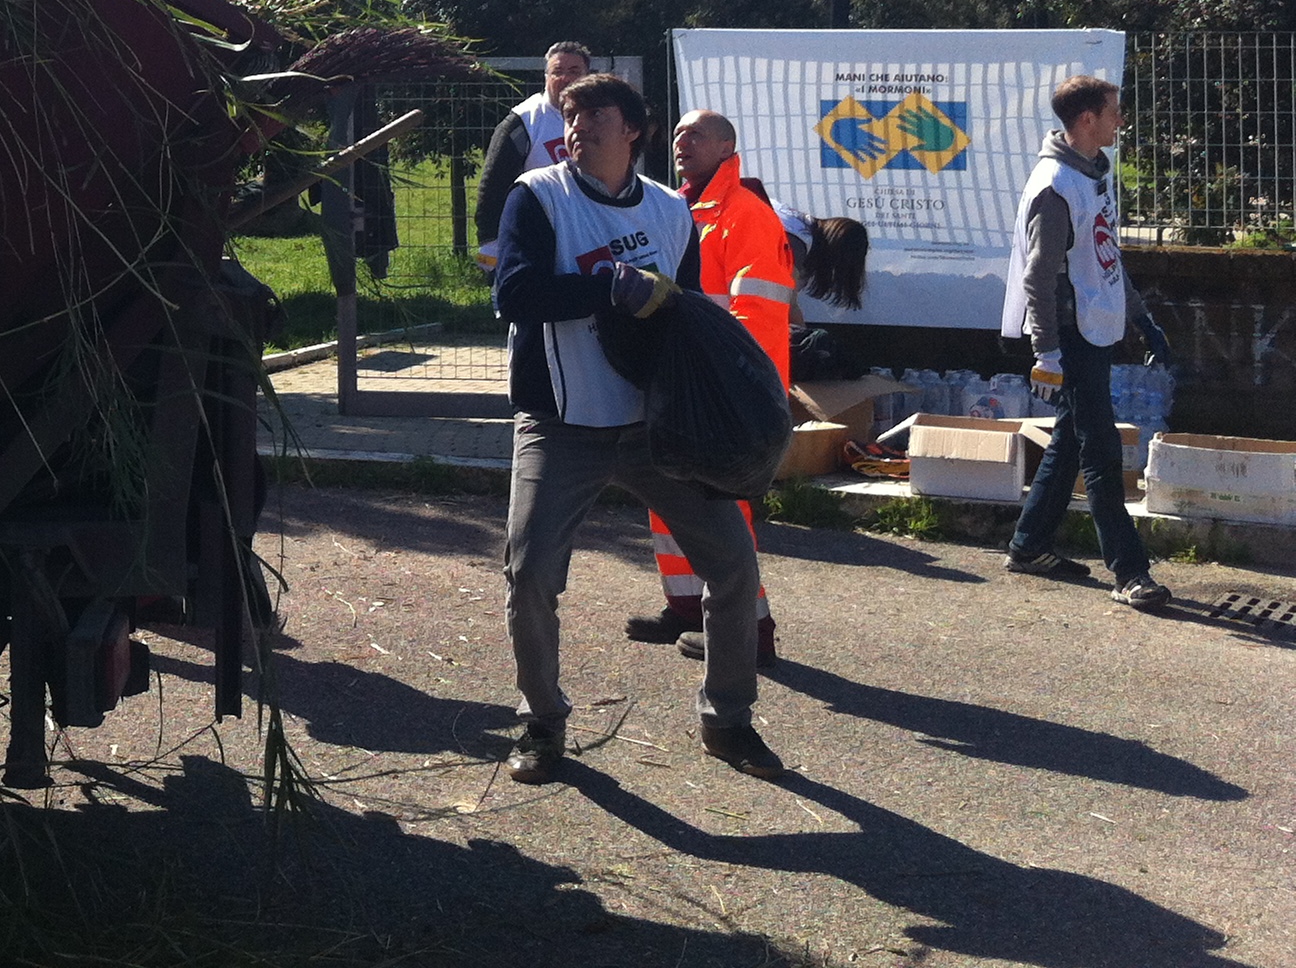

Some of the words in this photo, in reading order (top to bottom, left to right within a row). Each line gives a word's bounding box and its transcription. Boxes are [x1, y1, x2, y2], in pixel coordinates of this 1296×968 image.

[835, 73, 865, 82] MANI
[869, 73, 890, 82] CHE
[889, 198, 945, 210] CRISTO
